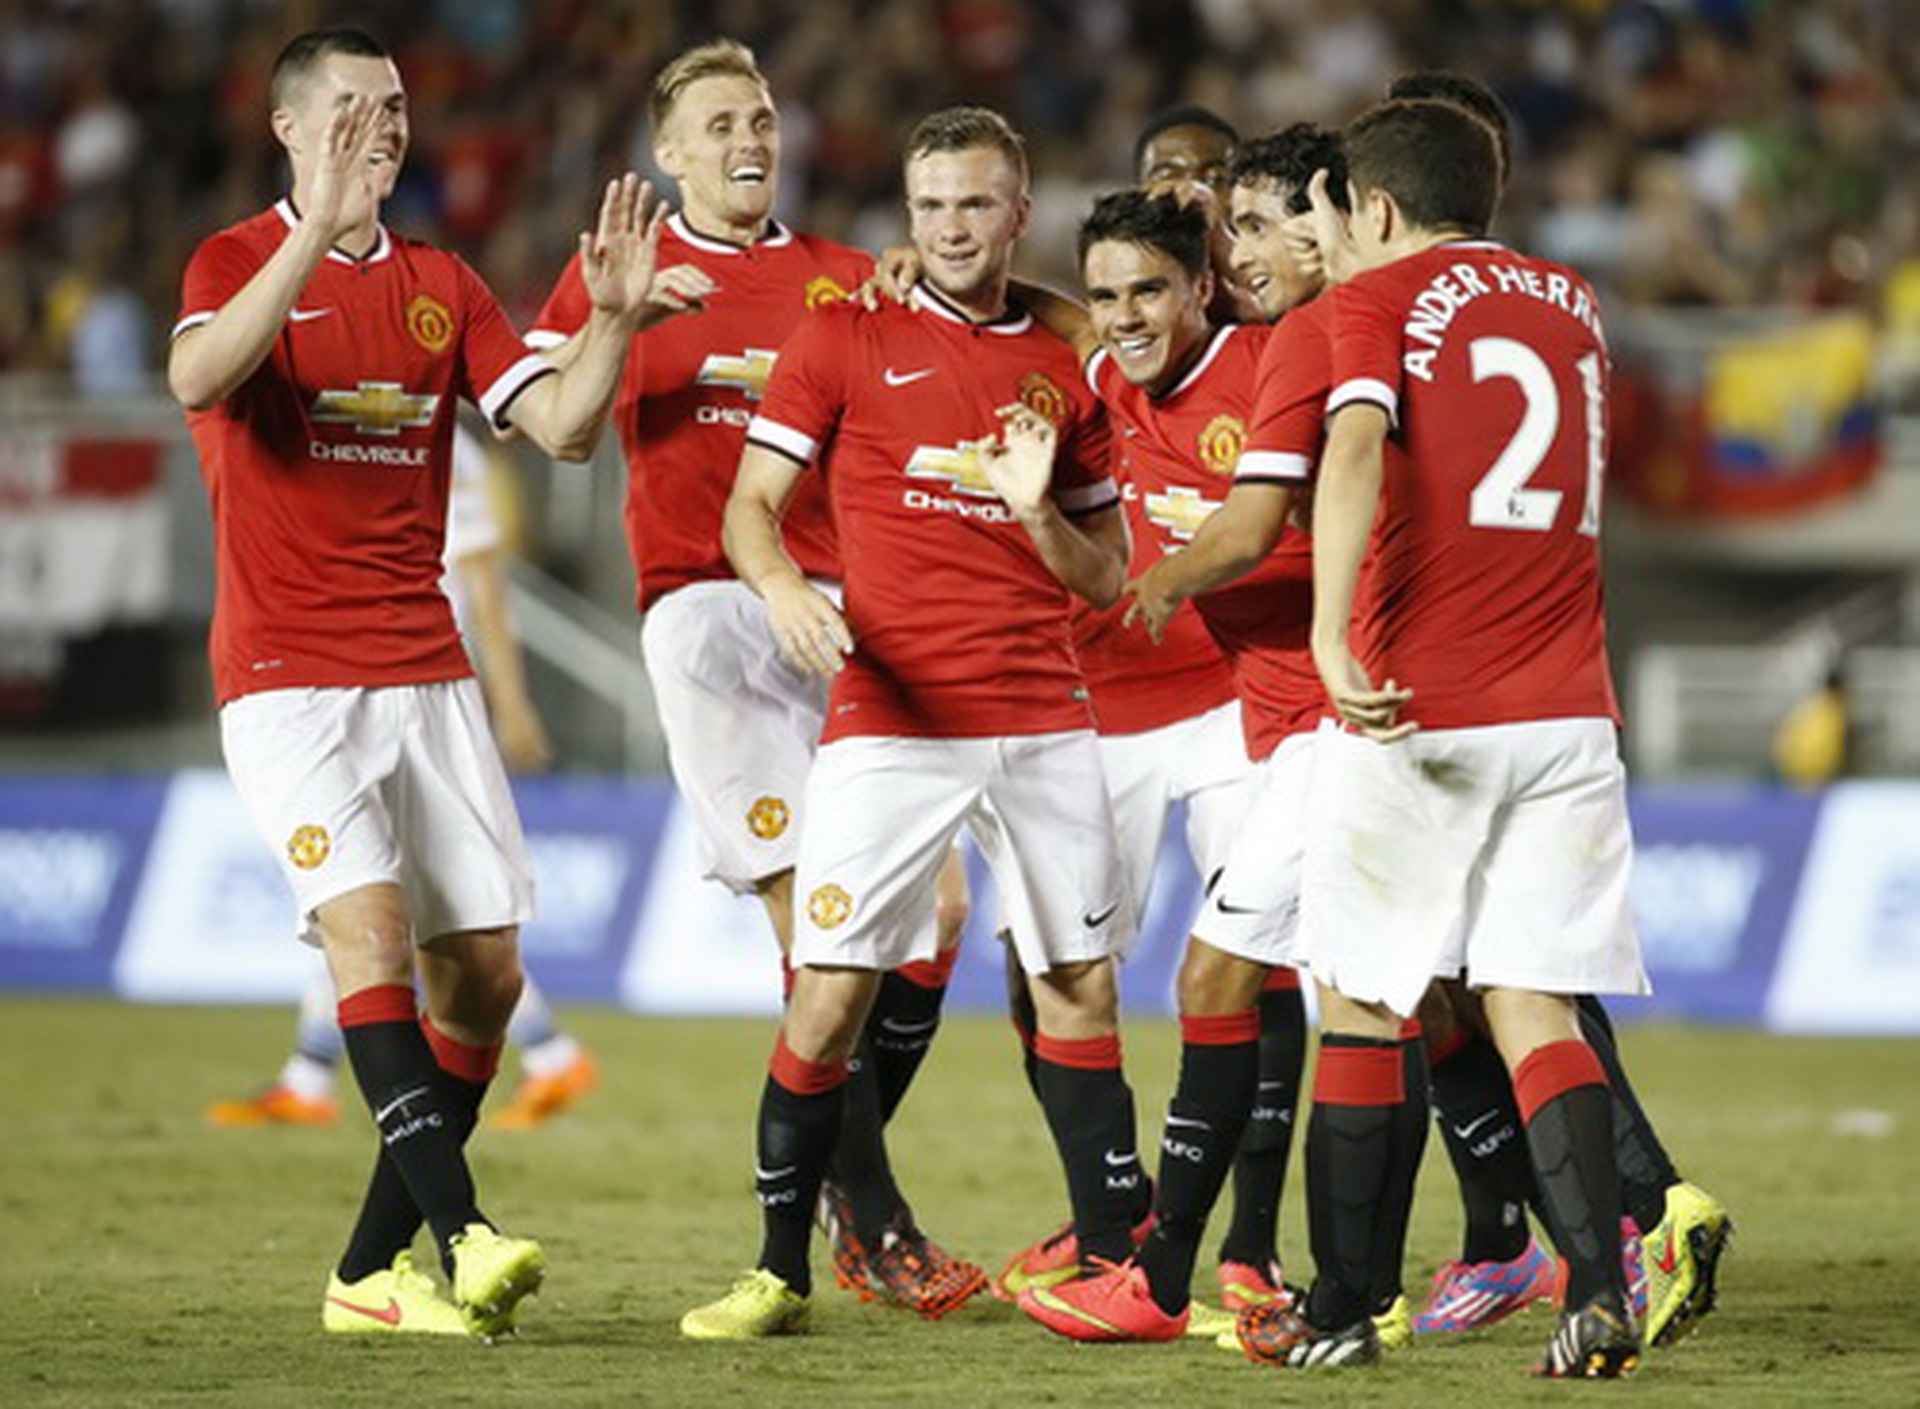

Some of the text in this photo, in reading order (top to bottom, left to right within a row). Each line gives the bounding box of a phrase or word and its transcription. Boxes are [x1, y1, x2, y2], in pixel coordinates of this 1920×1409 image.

[1403, 264, 1606, 381] ANDER HERR
[1469, 336, 1603, 537] 21
